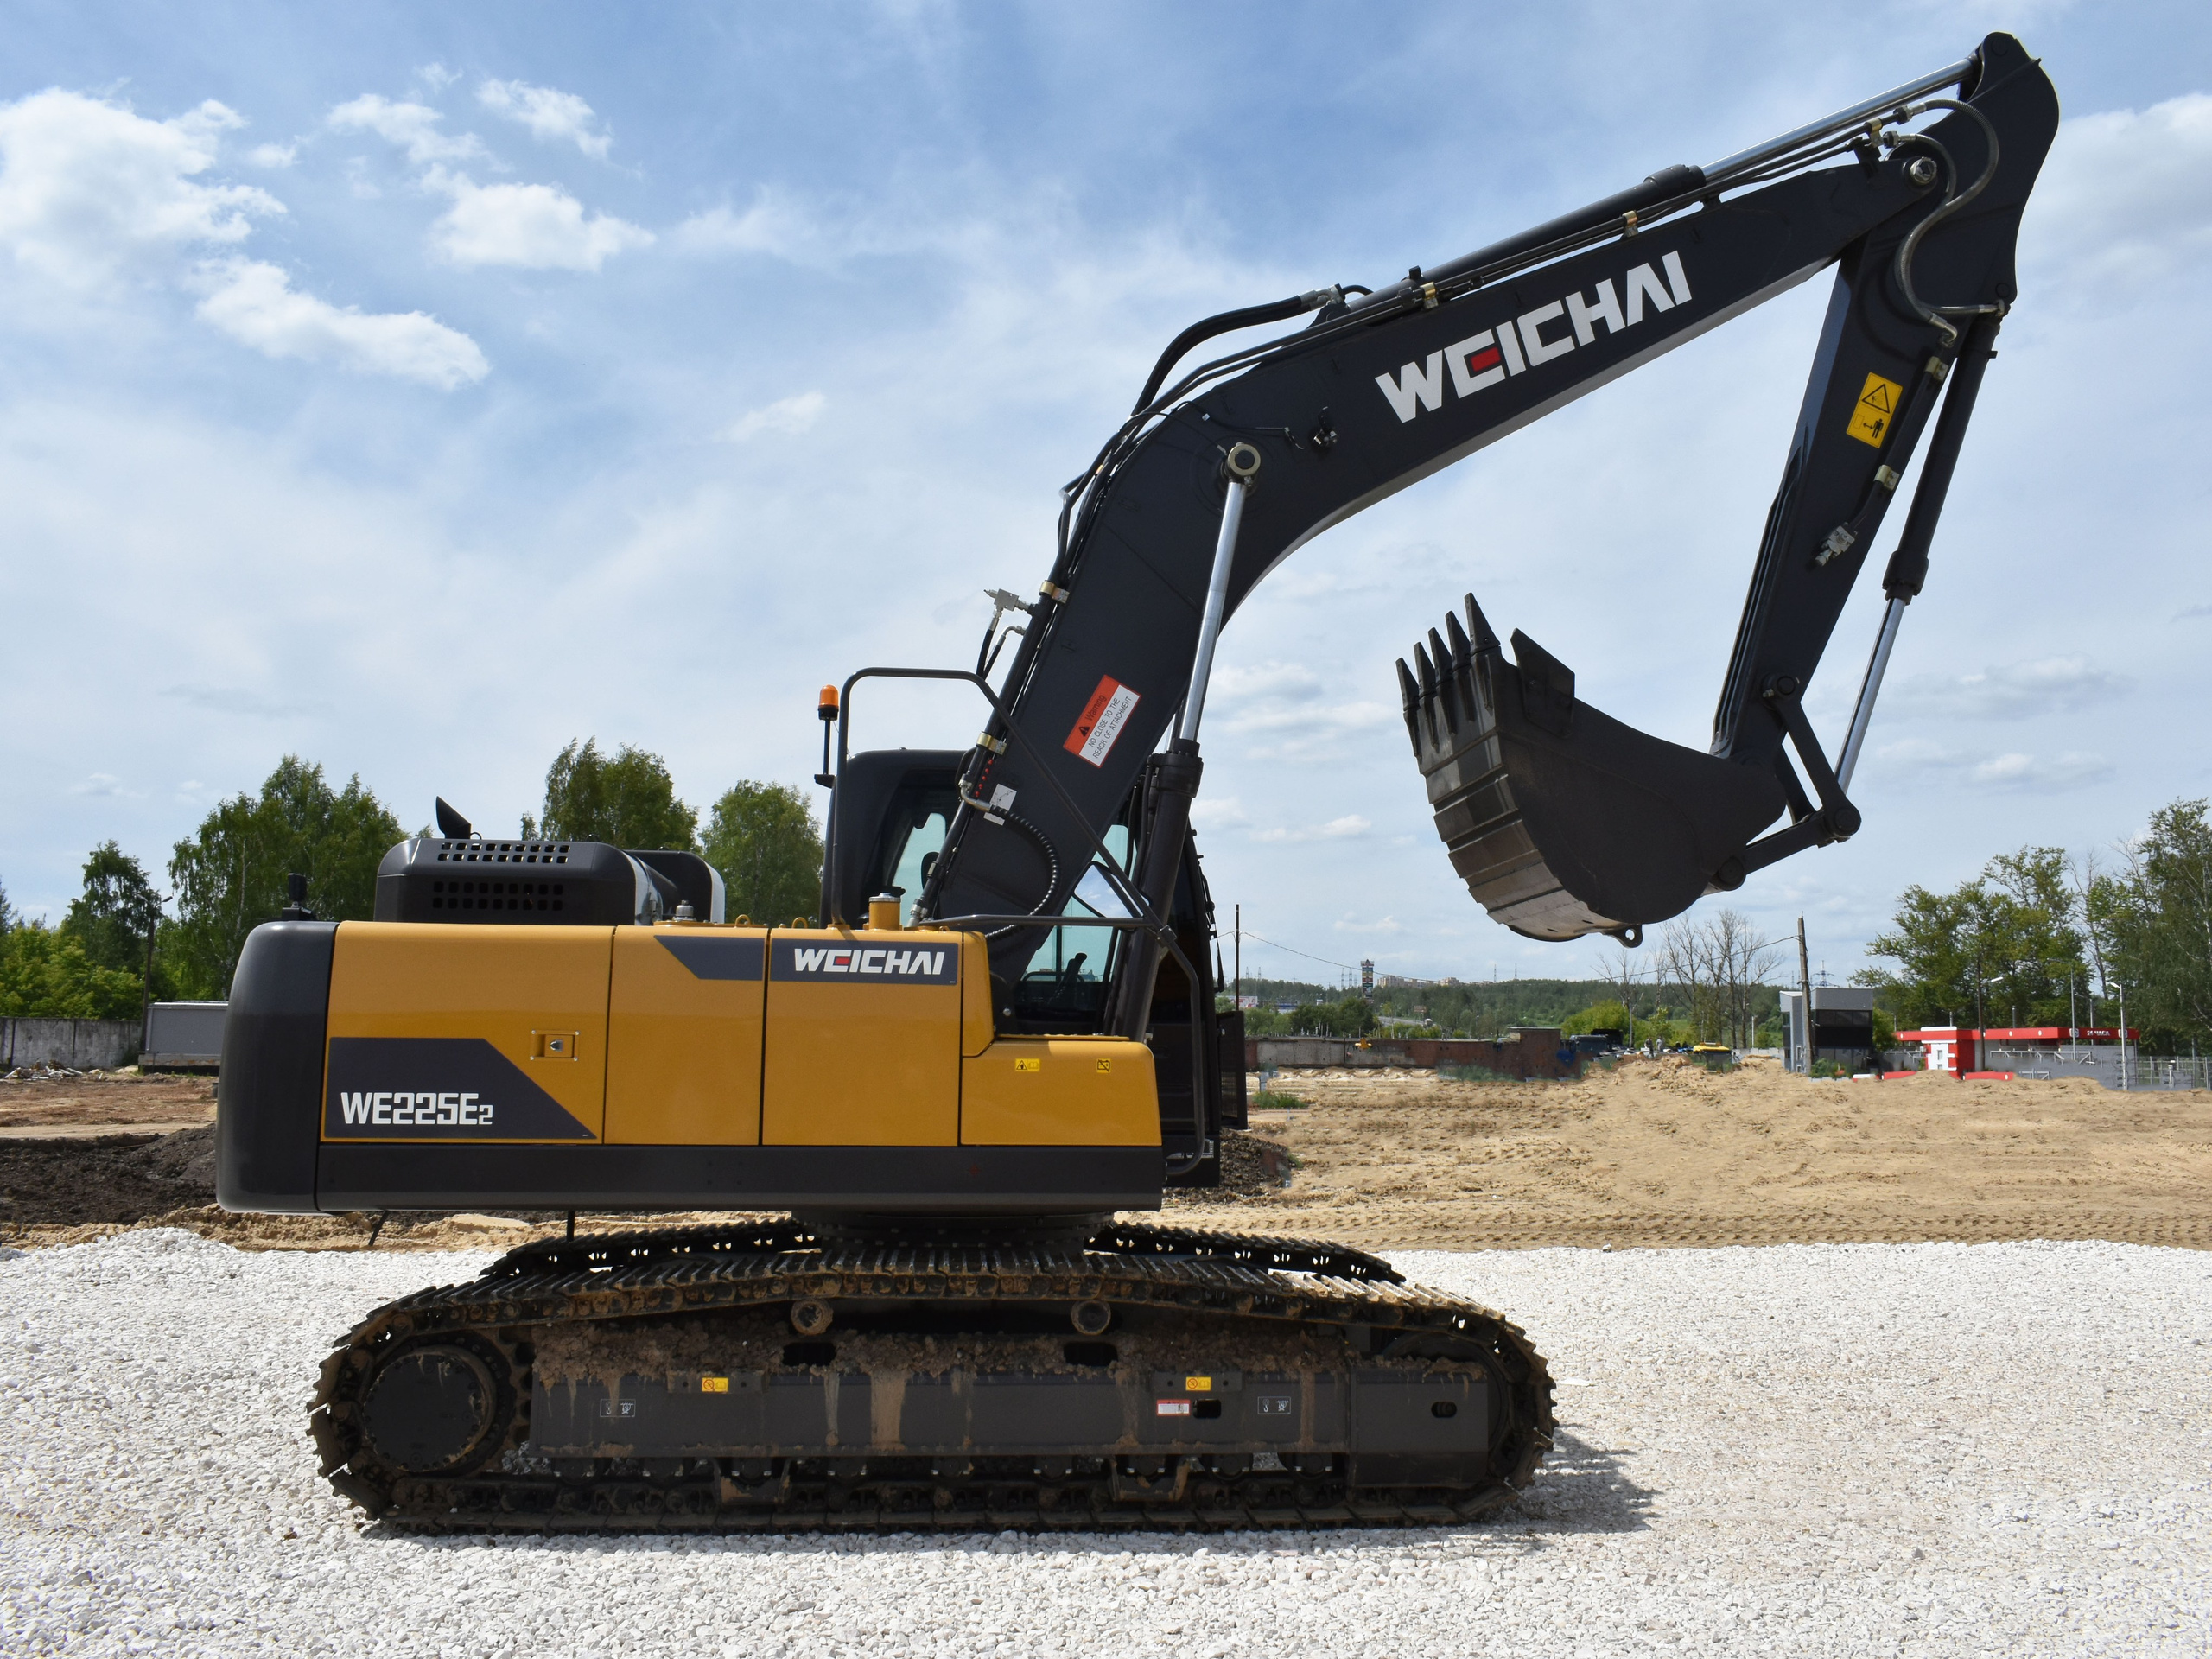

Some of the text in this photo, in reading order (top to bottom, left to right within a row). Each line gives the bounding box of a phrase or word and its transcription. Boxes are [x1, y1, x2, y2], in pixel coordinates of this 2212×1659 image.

[1375, 250, 1692, 423] WEICHAI
[1085, 695, 1107, 721] Warning
[1089, 738, 1097, 747] NO
[1095, 719, 1108, 737] CLOSE
[1110, 697, 1121, 709] THE
[1092, 696, 1132, 758] REACH OF ATTACHMENT
[794, 948, 945, 976] WEICHAI
[340, 1091, 493, 1125] WE225E2
